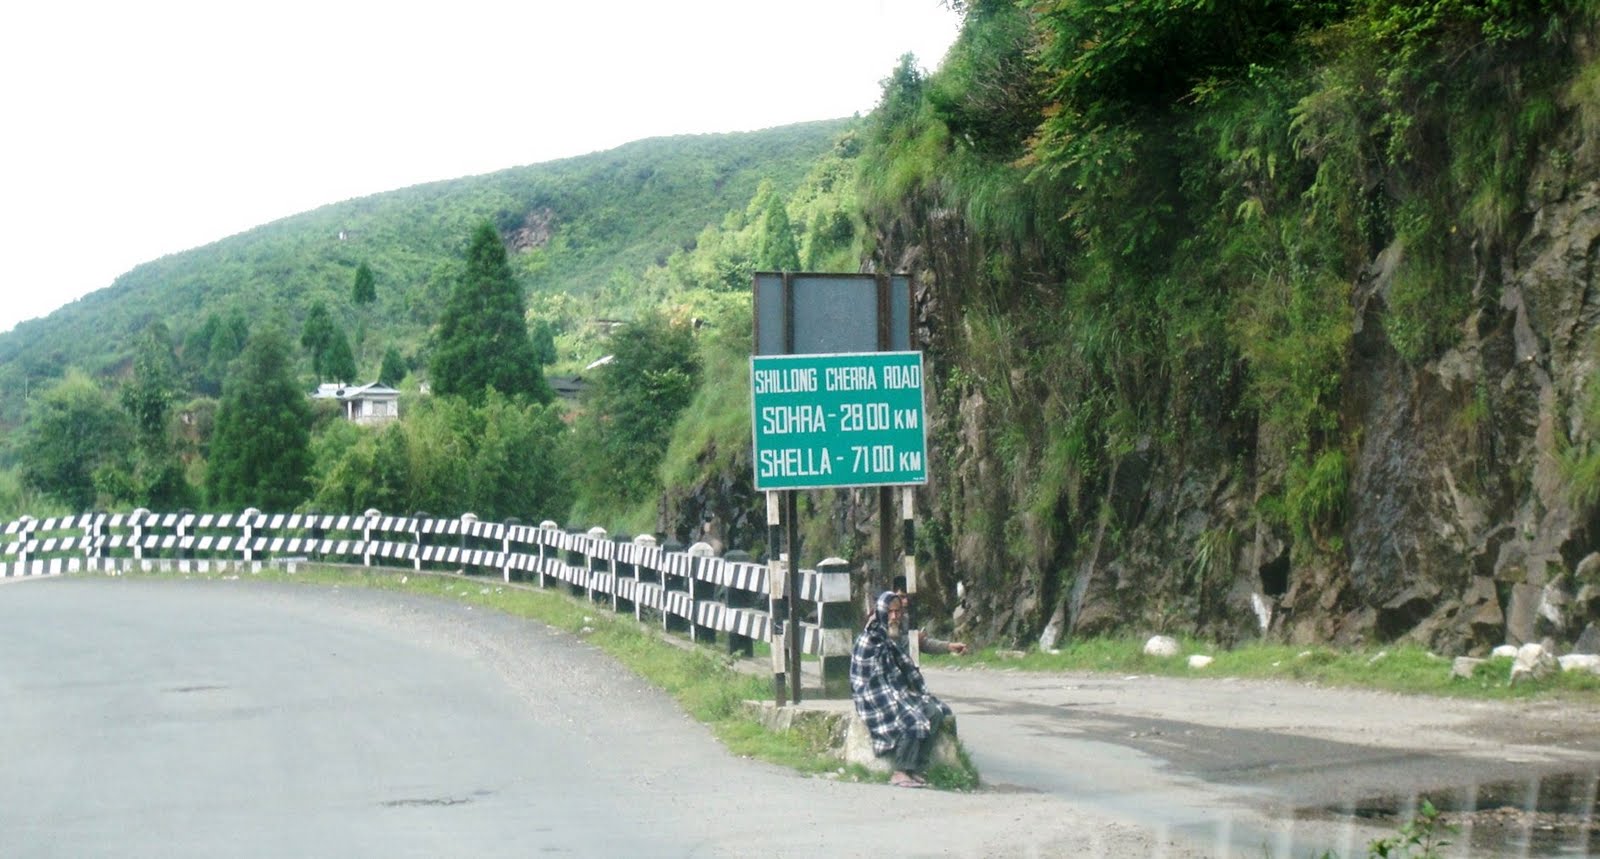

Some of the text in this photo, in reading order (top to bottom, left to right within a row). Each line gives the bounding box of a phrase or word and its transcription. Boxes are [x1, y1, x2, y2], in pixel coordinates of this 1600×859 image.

[755, 365, 920, 394] SHILLONG CHERRA ROAD
[894, 409, 918, 429] KM
[760, 448, 832, 477] SHELLA
[851, 445, 894, 473] 7100
[899, 451, 921, 471] KM
